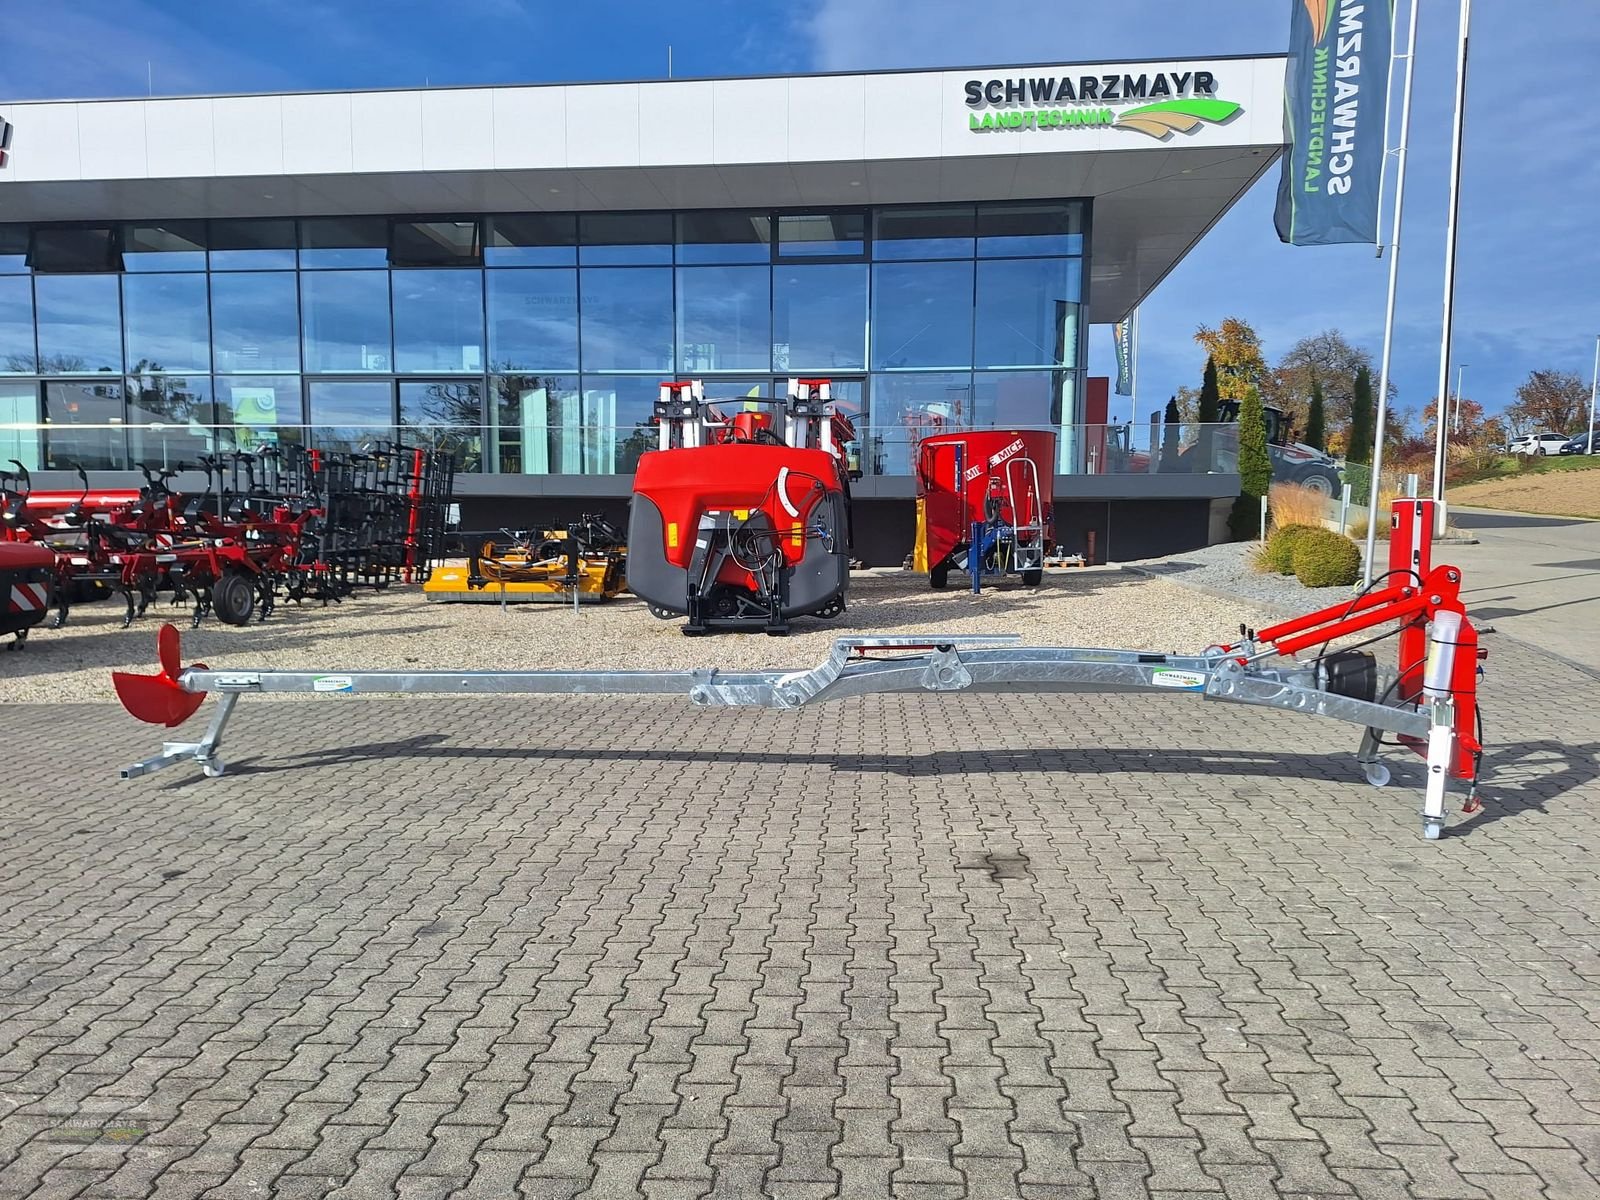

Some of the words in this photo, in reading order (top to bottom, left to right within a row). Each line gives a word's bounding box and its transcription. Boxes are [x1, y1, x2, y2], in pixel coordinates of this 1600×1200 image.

[964, 71, 1214, 104] SCHWARZMAYR
[969, 108, 1114, 131] LANDTECHNIK
[998, 439, 1025, 461] MICH
